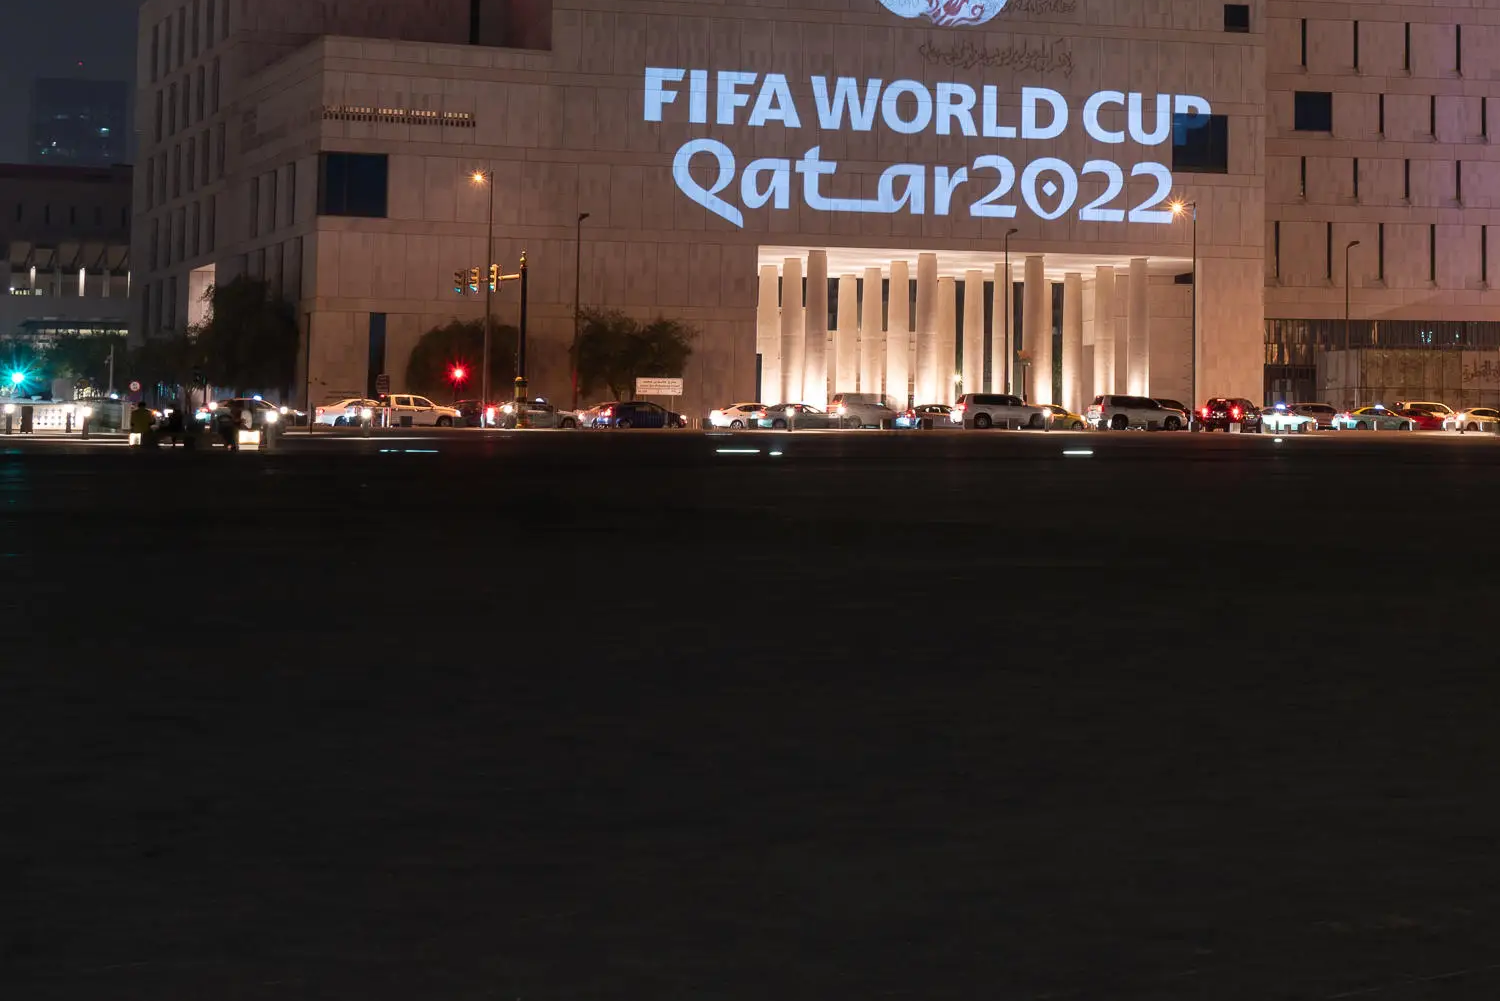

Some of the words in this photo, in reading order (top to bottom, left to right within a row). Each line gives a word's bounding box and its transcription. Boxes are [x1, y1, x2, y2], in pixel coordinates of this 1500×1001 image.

[644, 68, 802, 129] FIFA
[811, 76, 1068, 140] WORLD
[1083, 91, 1213, 146] CUP
